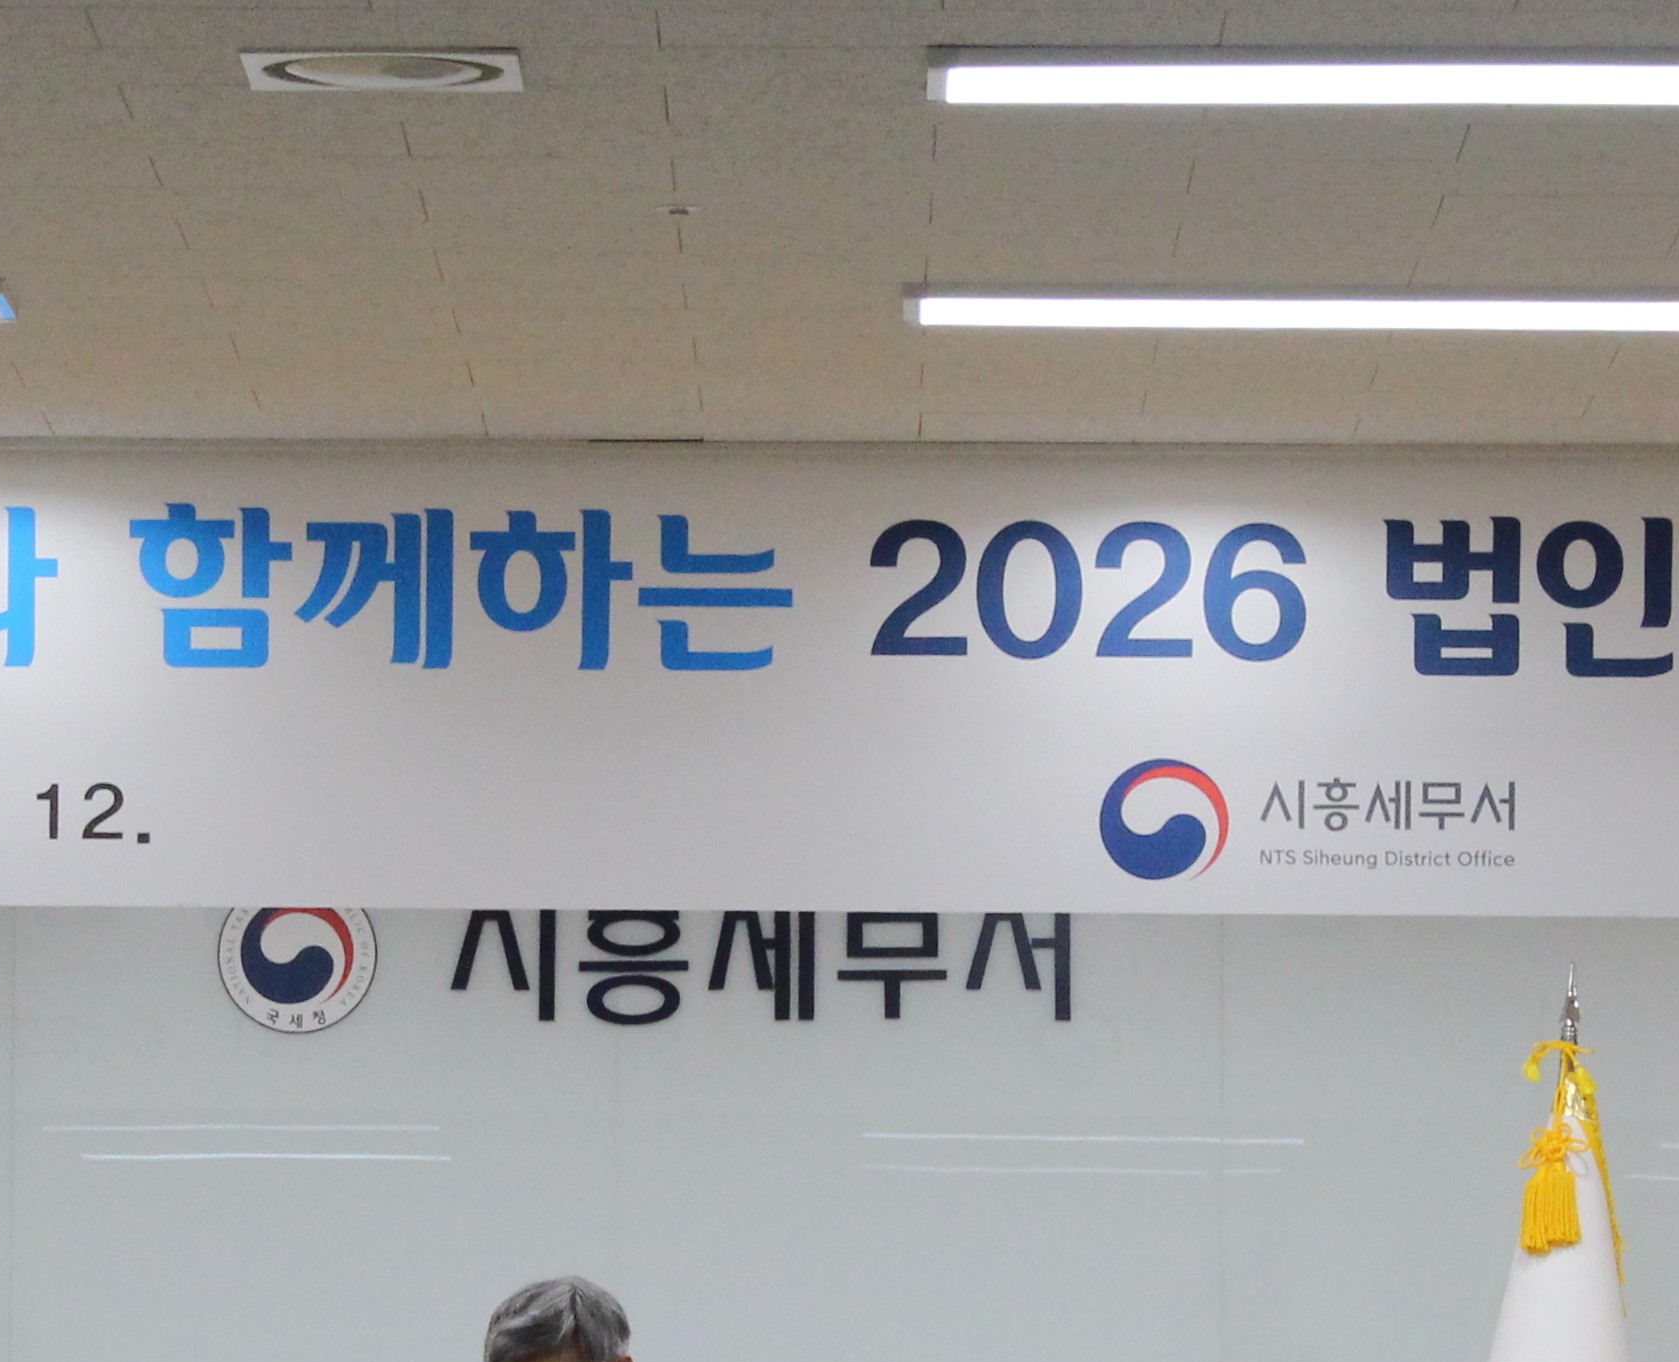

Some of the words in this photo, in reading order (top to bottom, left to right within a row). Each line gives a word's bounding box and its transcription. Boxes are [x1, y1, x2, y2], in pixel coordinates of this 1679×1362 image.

[129, 502, 794, 672] 함께하는
[870, 518, 1307, 662] 2026
[36, 782, 151, 845] 12.
[1260, 777, 1516, 832] 시흥세무서
[1259, 849, 1297, 866] NTS
[1303, 849, 1378, 870] Siheung
[1384, 850, 1451, 867] District
[1457, 850, 1516, 868] Office
[450, 909, 1072, 1027] 시흥세무서
[266, 1008, 327, 1030] 국세청
